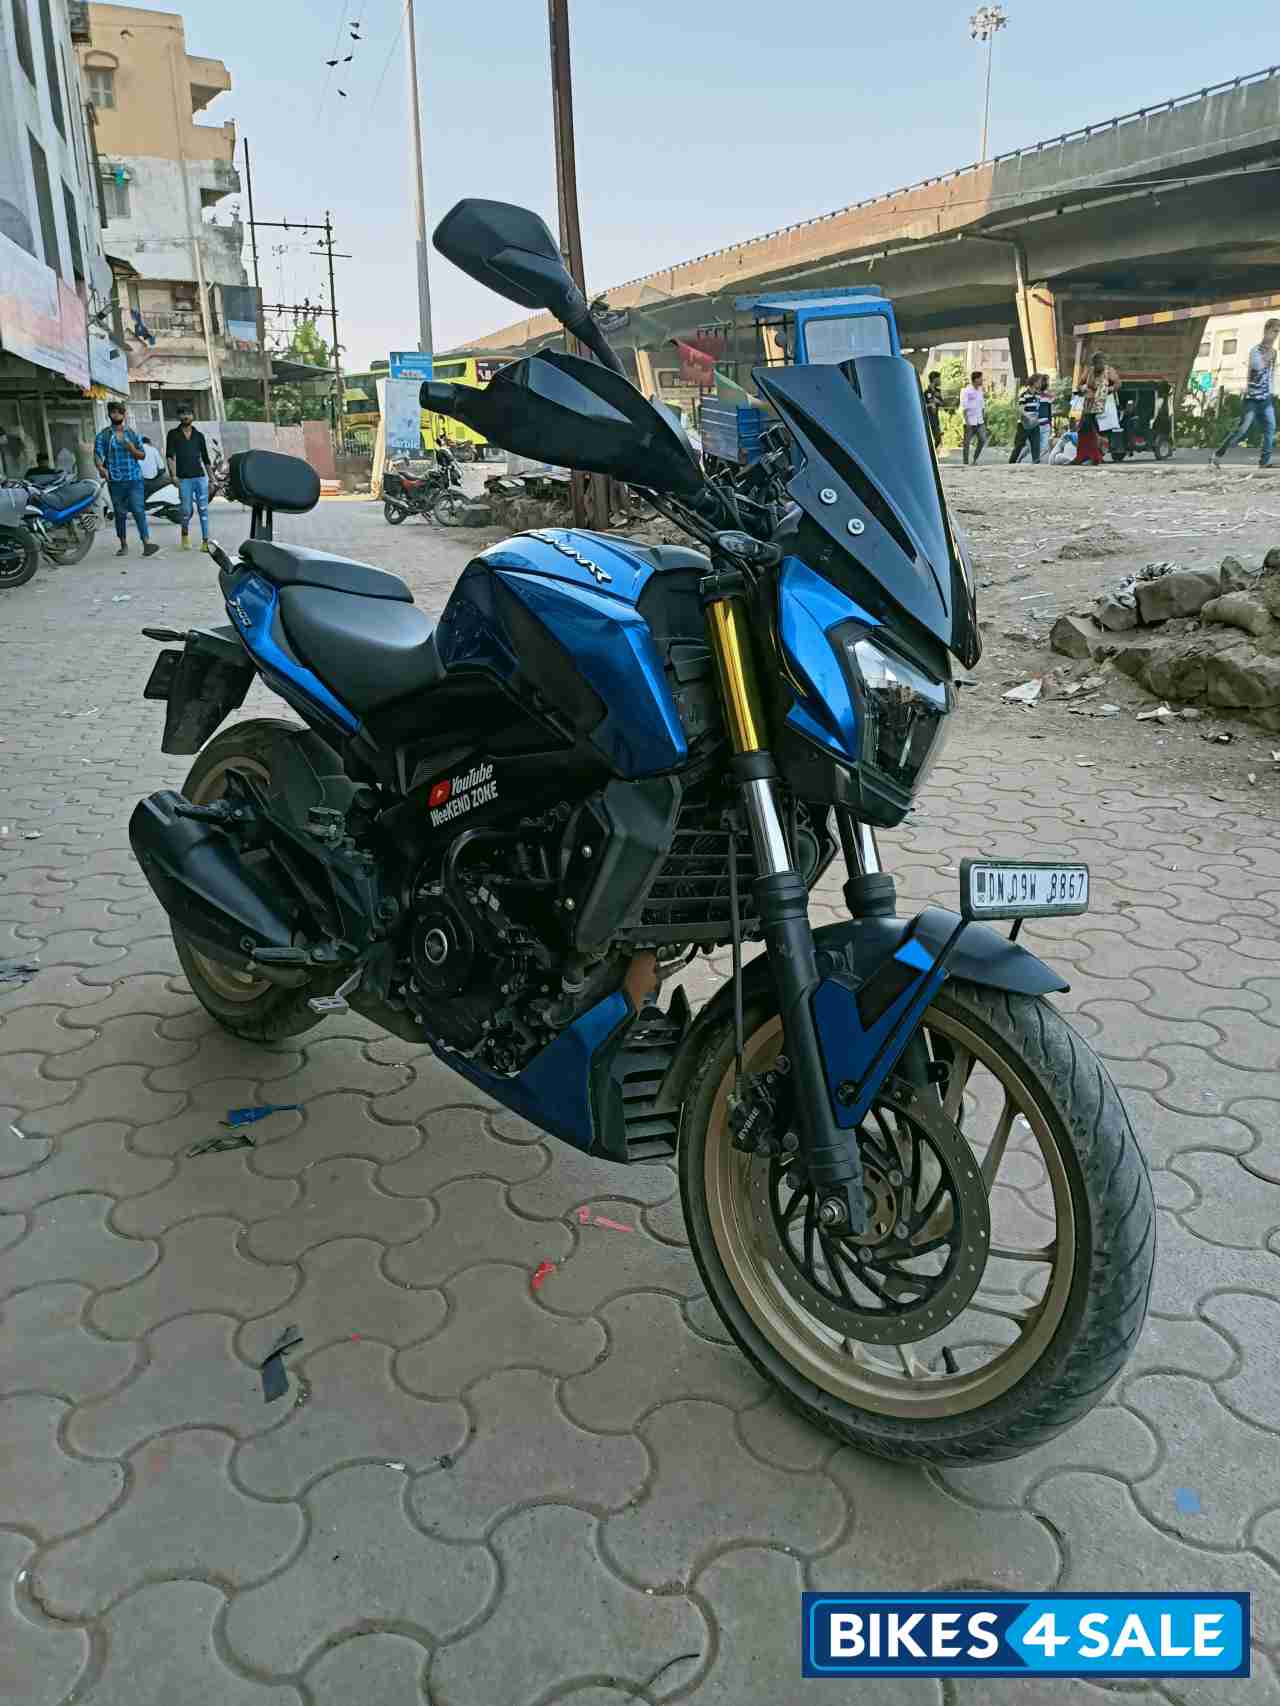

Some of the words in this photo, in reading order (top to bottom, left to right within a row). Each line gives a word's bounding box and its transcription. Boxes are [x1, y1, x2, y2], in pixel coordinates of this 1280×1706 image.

[451, 762, 494, 796] YouTube
[470, 780, 499, 808] ZONE
[1050, 873, 1085, 900] 8867
